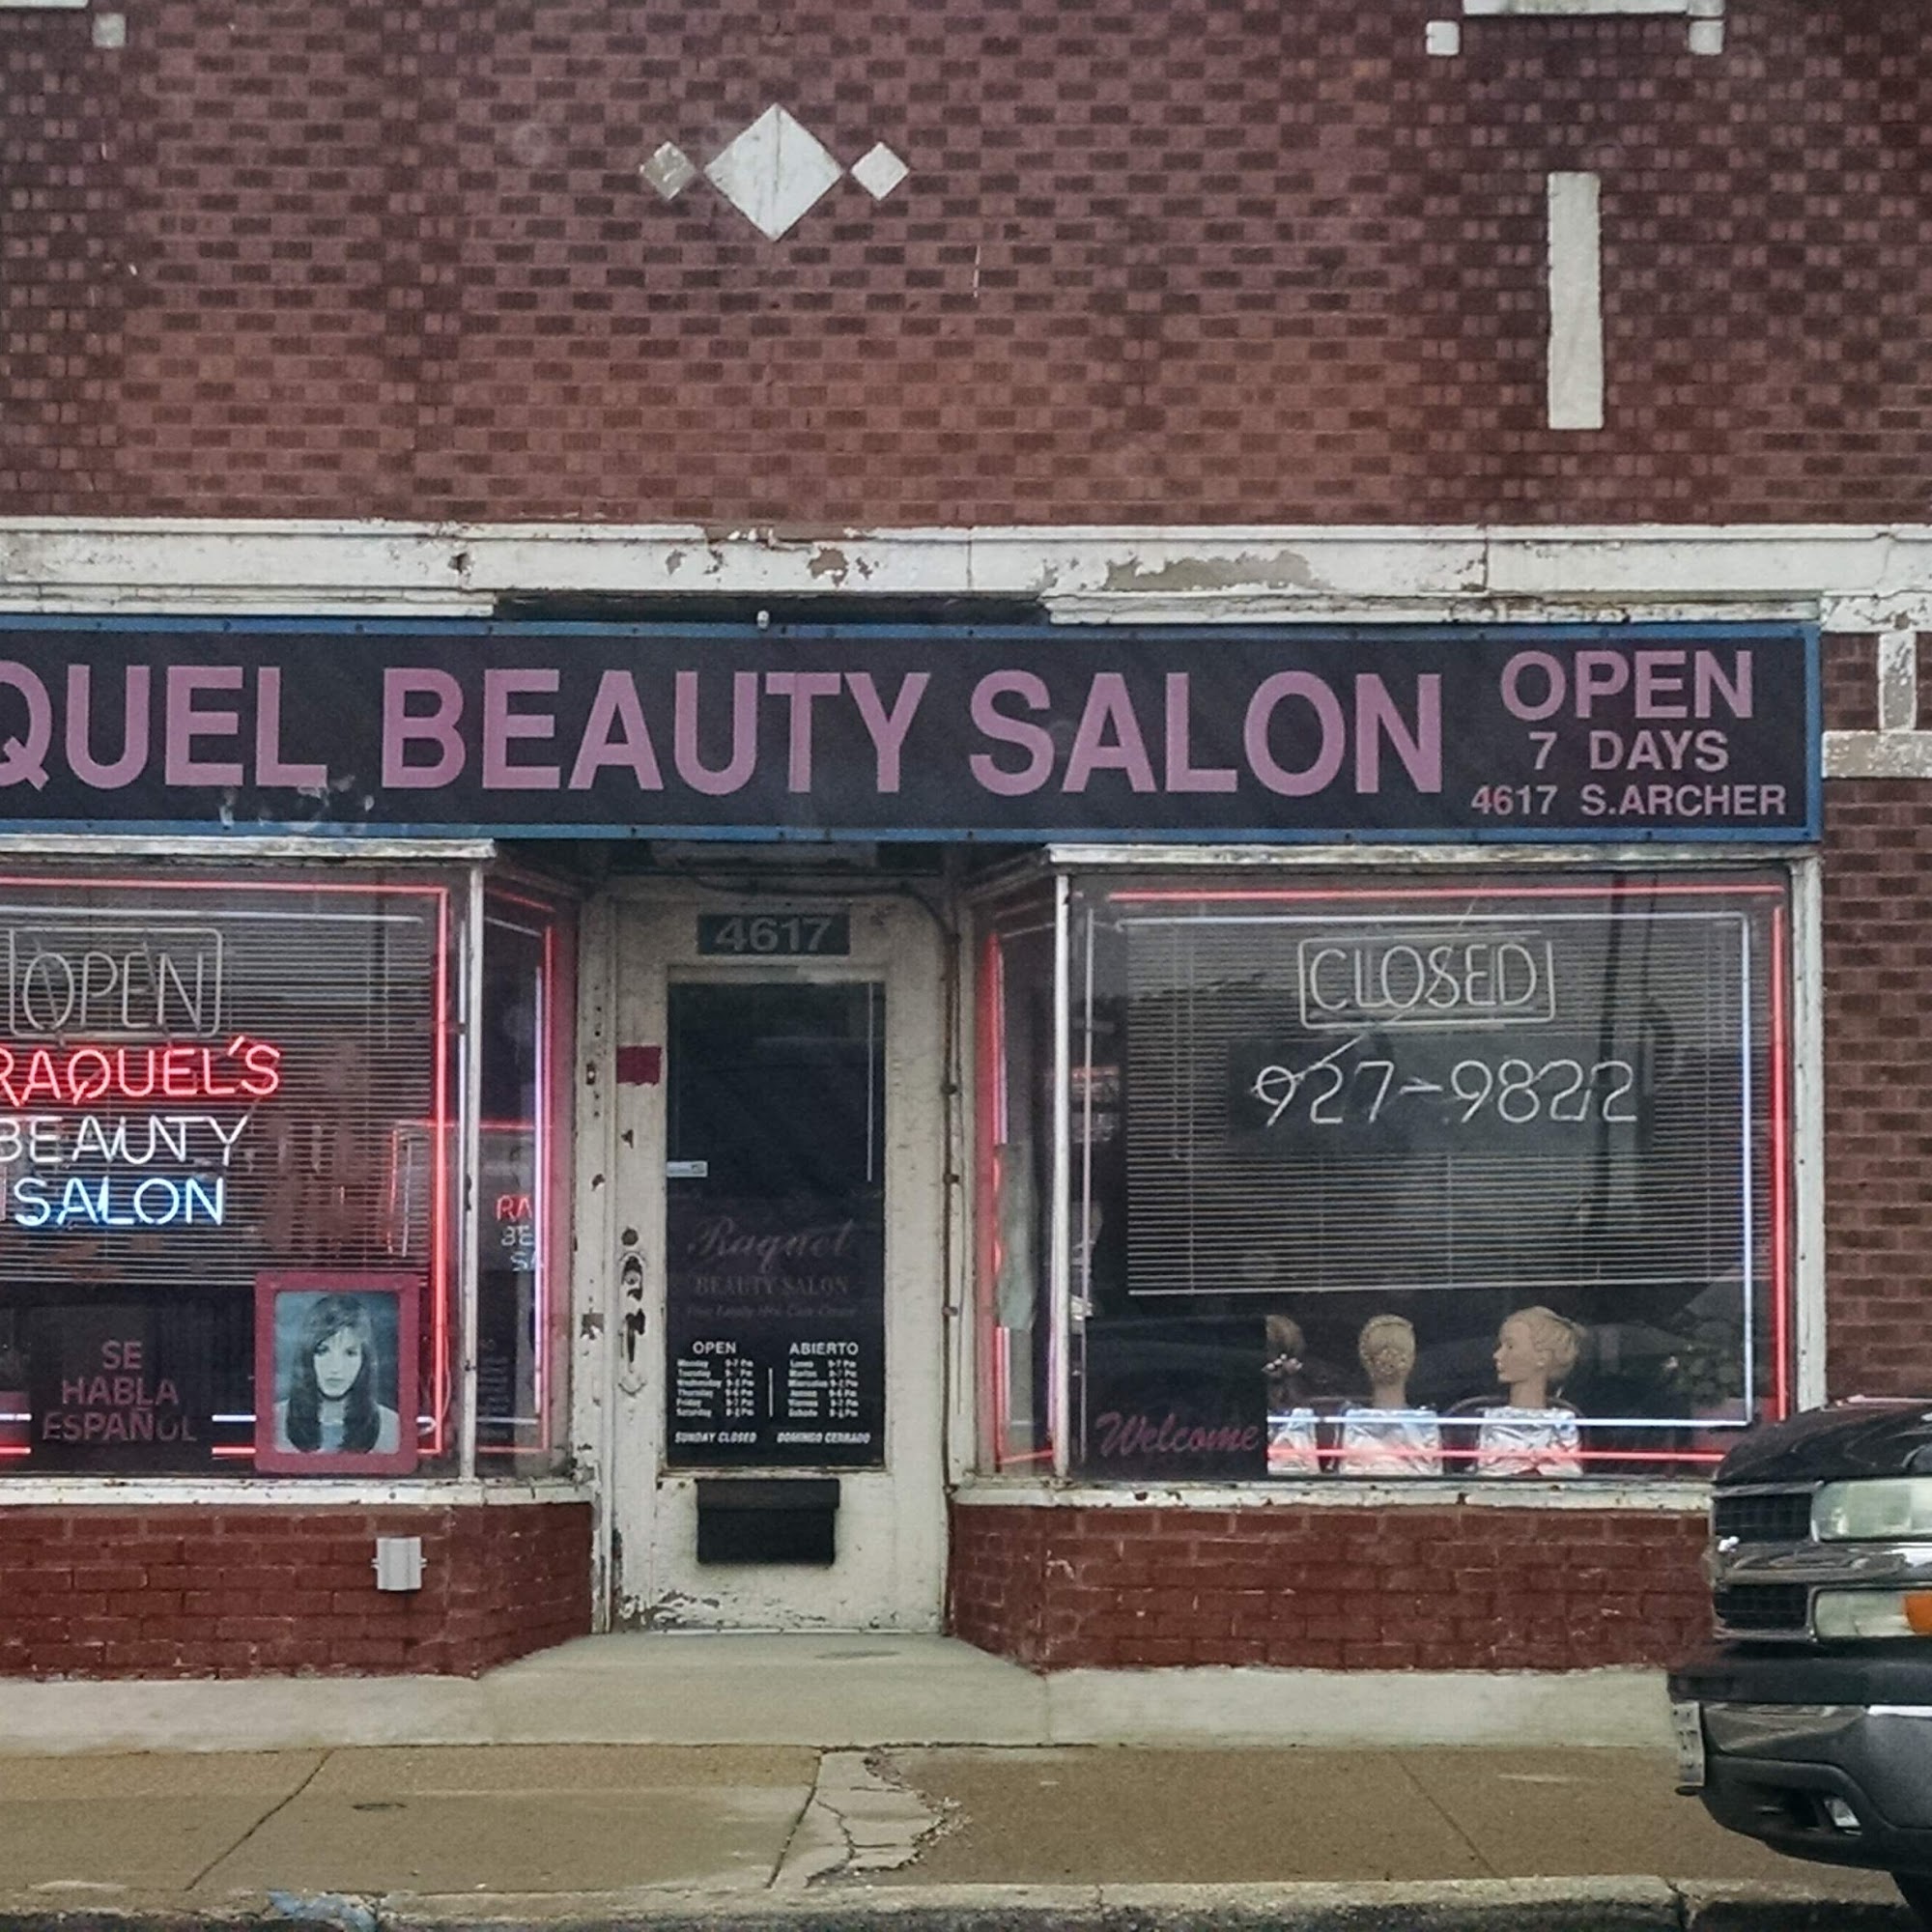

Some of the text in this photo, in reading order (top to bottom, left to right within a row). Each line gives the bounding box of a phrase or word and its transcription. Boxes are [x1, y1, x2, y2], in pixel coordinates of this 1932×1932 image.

[1500, 649, 1752, 721] OPEN
[382, 668, 930, 795] BEAUTY
[969, 668, 1441, 797] SALON
[1529, 730, 1729, 772] 7 DAYS
[1470, 783, 1786, 816] 4617 S.ARCHER
[716, 917, 833, 952] 4617
[23, 951, 205, 1032] OPEN
[1310, 943, 1537, 1010] CLOSED
[1254, 1058, 1637, 1128] 927-9822
[14, 1176, 224, 1226] SALON
[101, 1339, 143, 1370] SE
[693, 1341, 736, 1354] OPEN
[789, 1342, 859, 1355] ABIERTO
[61, 1375, 180, 1406] HABLA
[42, 1406, 198, 1442] ESPAÑOL
[1095, 1411, 1260, 1457] Welcome
